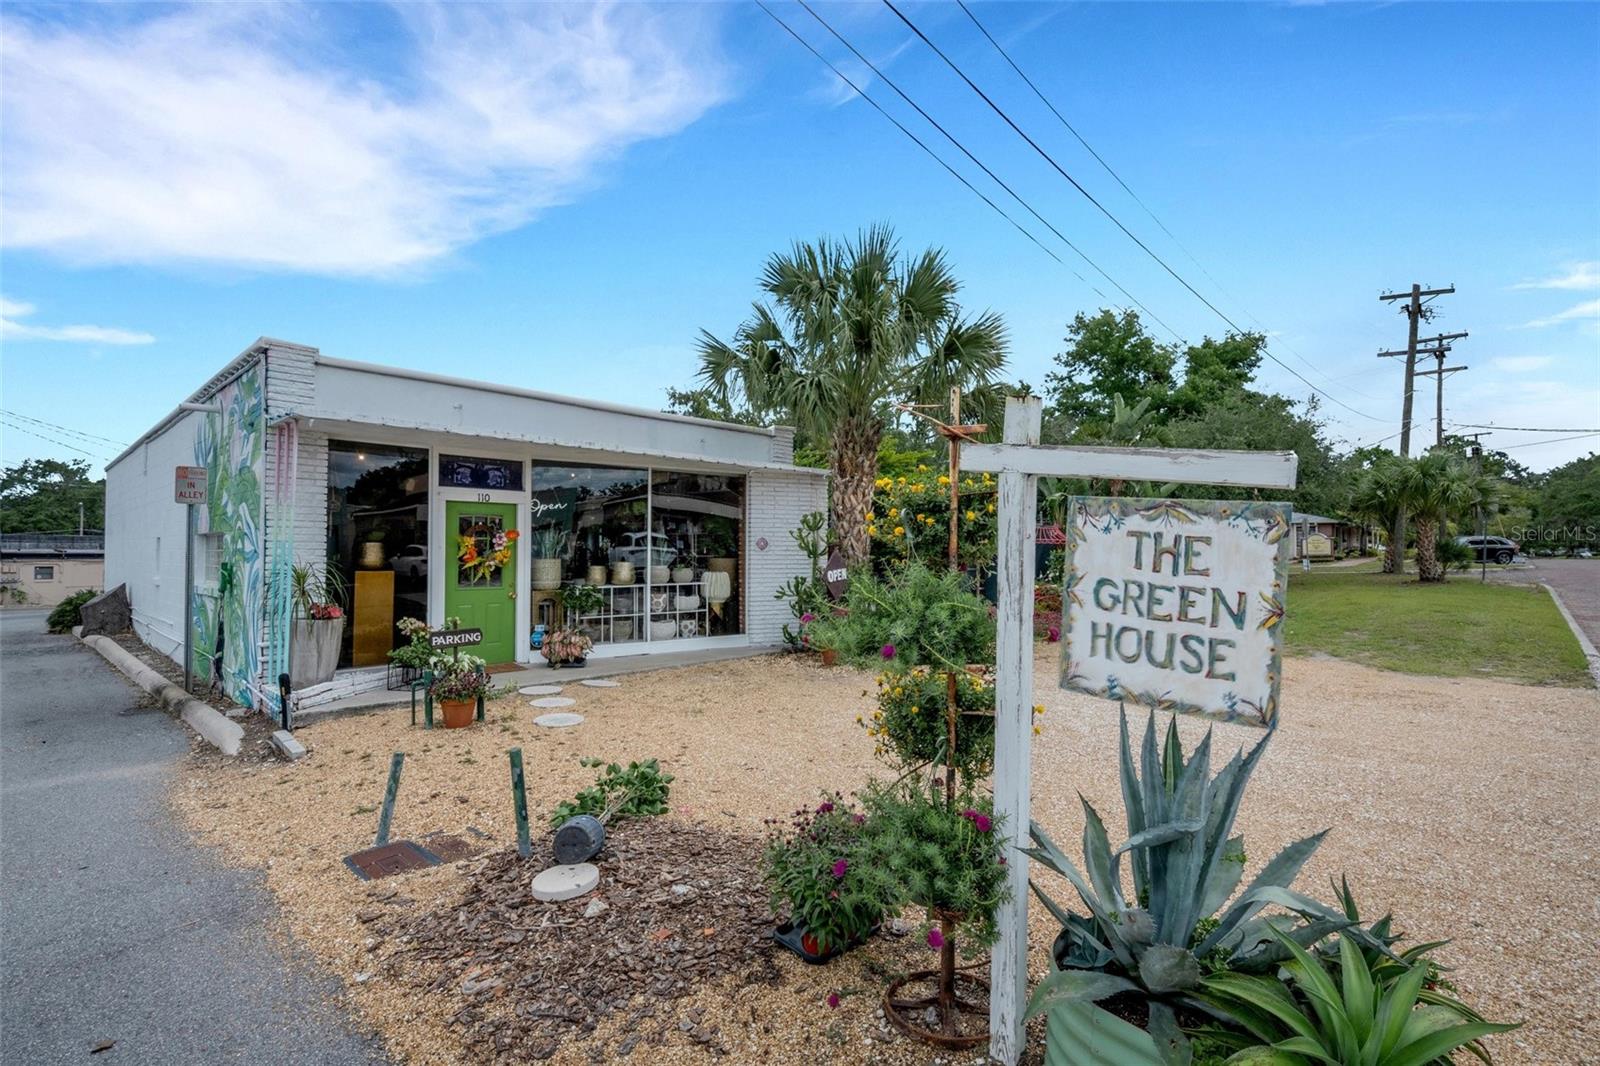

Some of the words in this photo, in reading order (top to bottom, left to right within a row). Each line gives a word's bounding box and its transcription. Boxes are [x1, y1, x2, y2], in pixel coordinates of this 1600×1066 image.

[187, 481, 195, 489] IN
[178, 490, 203, 498] ALLEY
[478, 493, 490, 502] 110
[531, 498, 568, 518] Open
[1126, 530, 1213, 577] THE
[827, 568, 847, 583] OPEN
[1093, 577, 1248, 631] GREEN
[432, 632, 481, 646] PARKING
[1089, 621, 1237, 682] HOUSE
